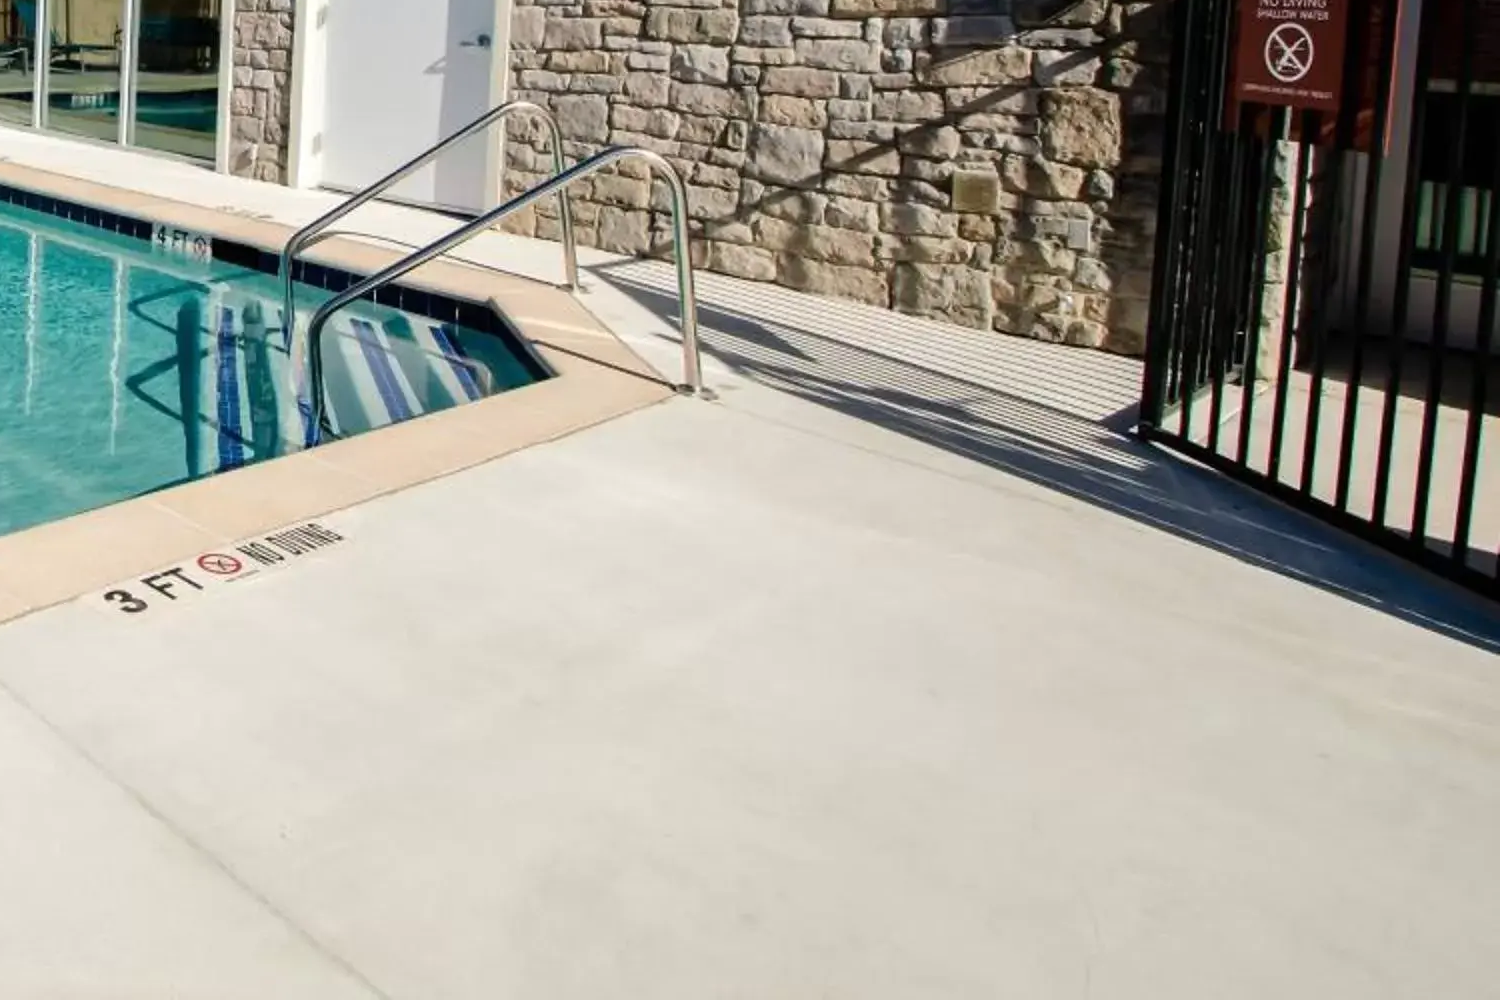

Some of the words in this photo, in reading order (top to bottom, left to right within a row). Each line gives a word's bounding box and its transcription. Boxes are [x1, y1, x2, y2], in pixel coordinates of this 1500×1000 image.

[157, 225, 166, 249] 4
[172, 229, 189, 252] FT
[103, 589, 148, 614] 3
[140, 567, 204, 600] FT
[236, 541, 285, 567] NO
[264, 523, 344, 556] DIVING
